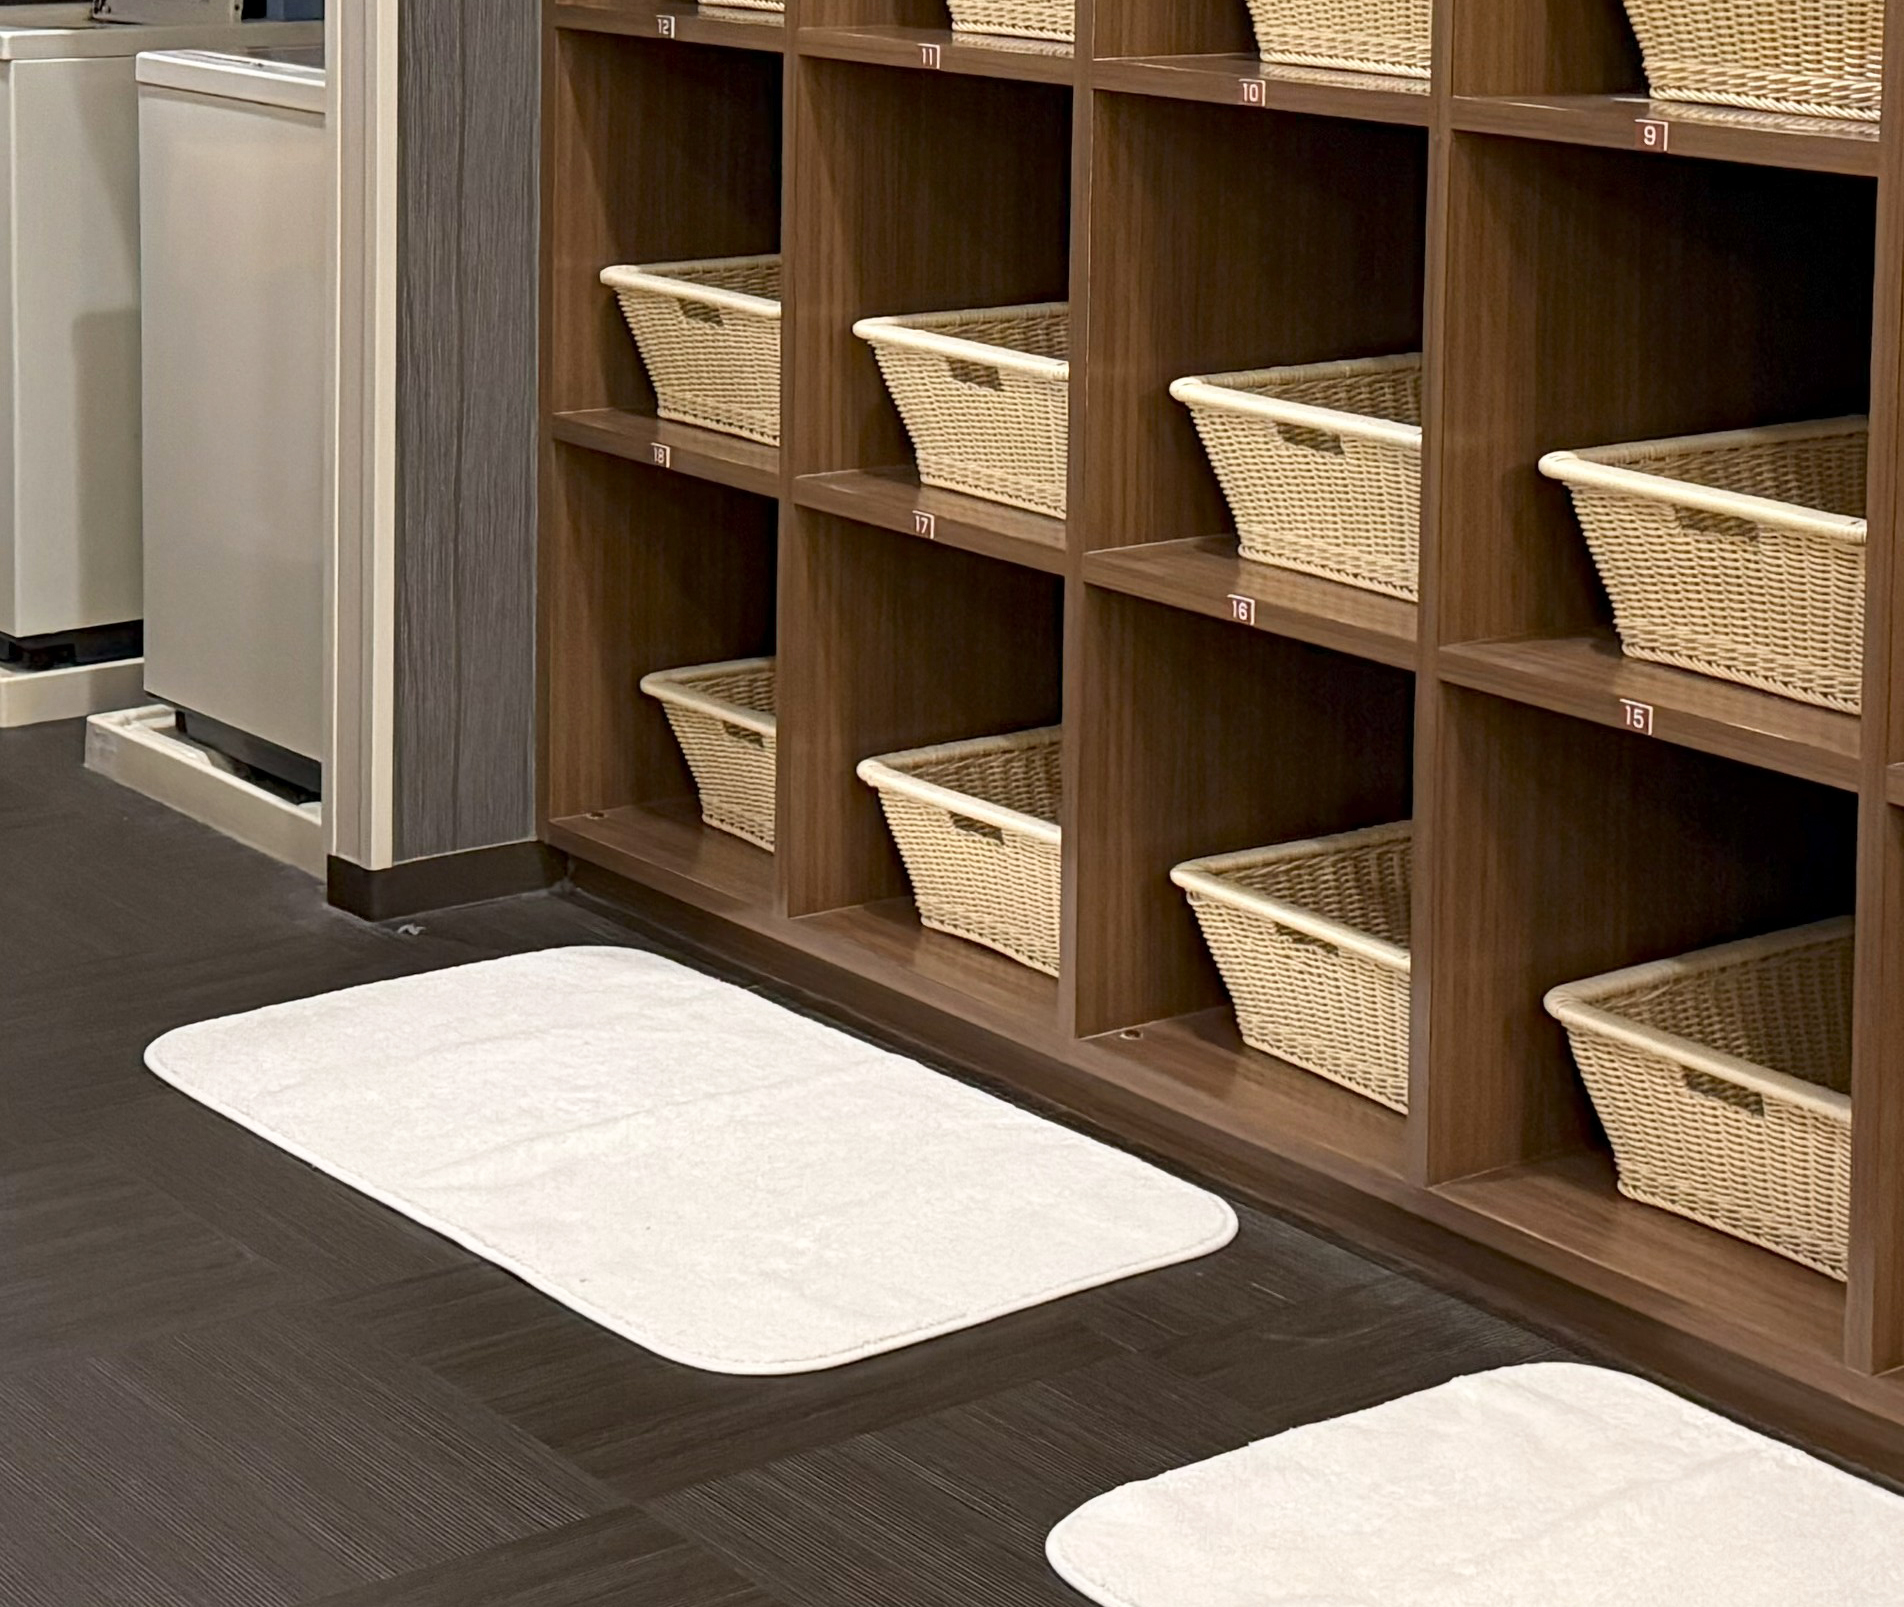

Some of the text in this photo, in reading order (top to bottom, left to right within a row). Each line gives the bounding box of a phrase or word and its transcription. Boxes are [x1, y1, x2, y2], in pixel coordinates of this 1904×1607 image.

[657, 18, 670, 35] 12
[922, 47, 934, 64] 11
[1243, 83, 1259, 102] 10
[1643, 126, 1657, 146] 9
[653, 446, 665, 463] 18
[915, 514, 928, 533] 17
[1232, 599, 1248, 620] 16
[1625, 705, 1645, 729] 15
